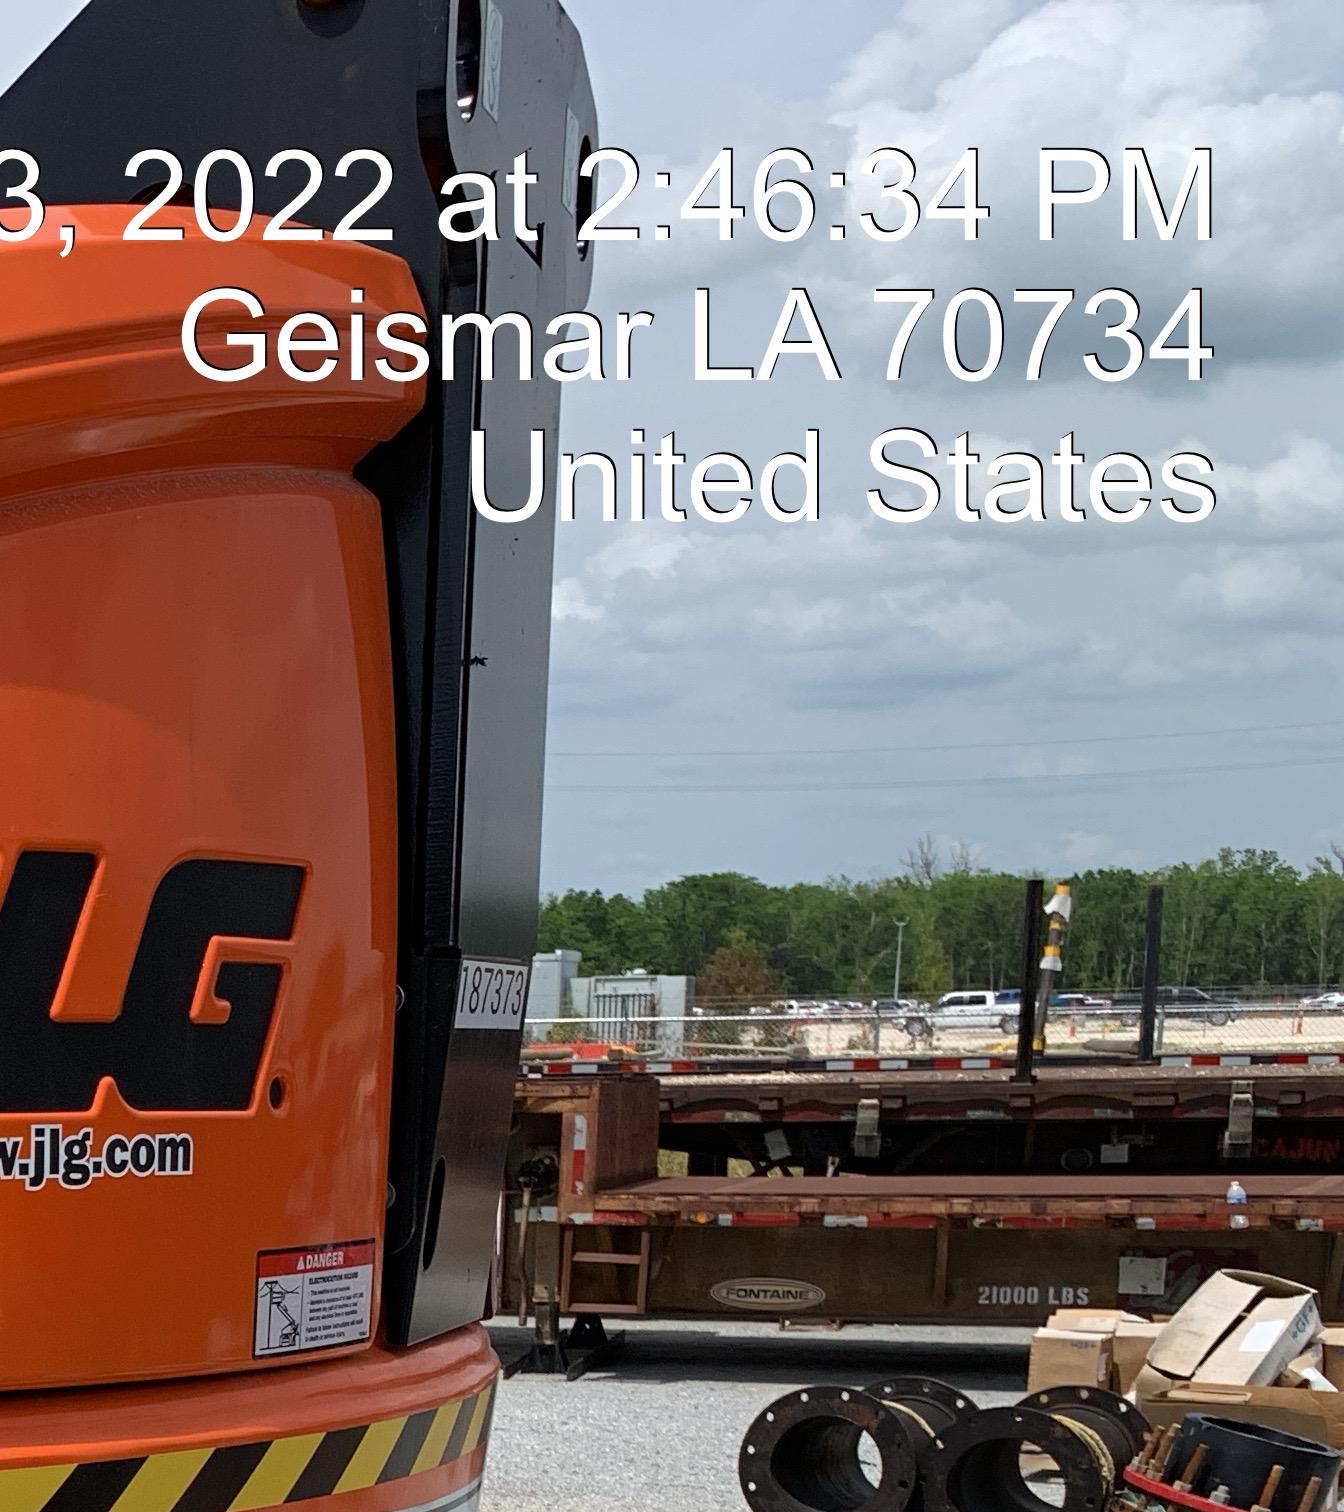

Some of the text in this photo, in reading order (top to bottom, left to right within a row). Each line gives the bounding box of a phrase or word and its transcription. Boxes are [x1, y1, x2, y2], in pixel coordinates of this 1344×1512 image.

[460, 965, 524, 1016] 187373
[305, 1250, 345, 1270] DANGER
[726, 1287, 810, 1301] FONTAINE
[977, 1286, 1090, 1306] 21000 LBS
